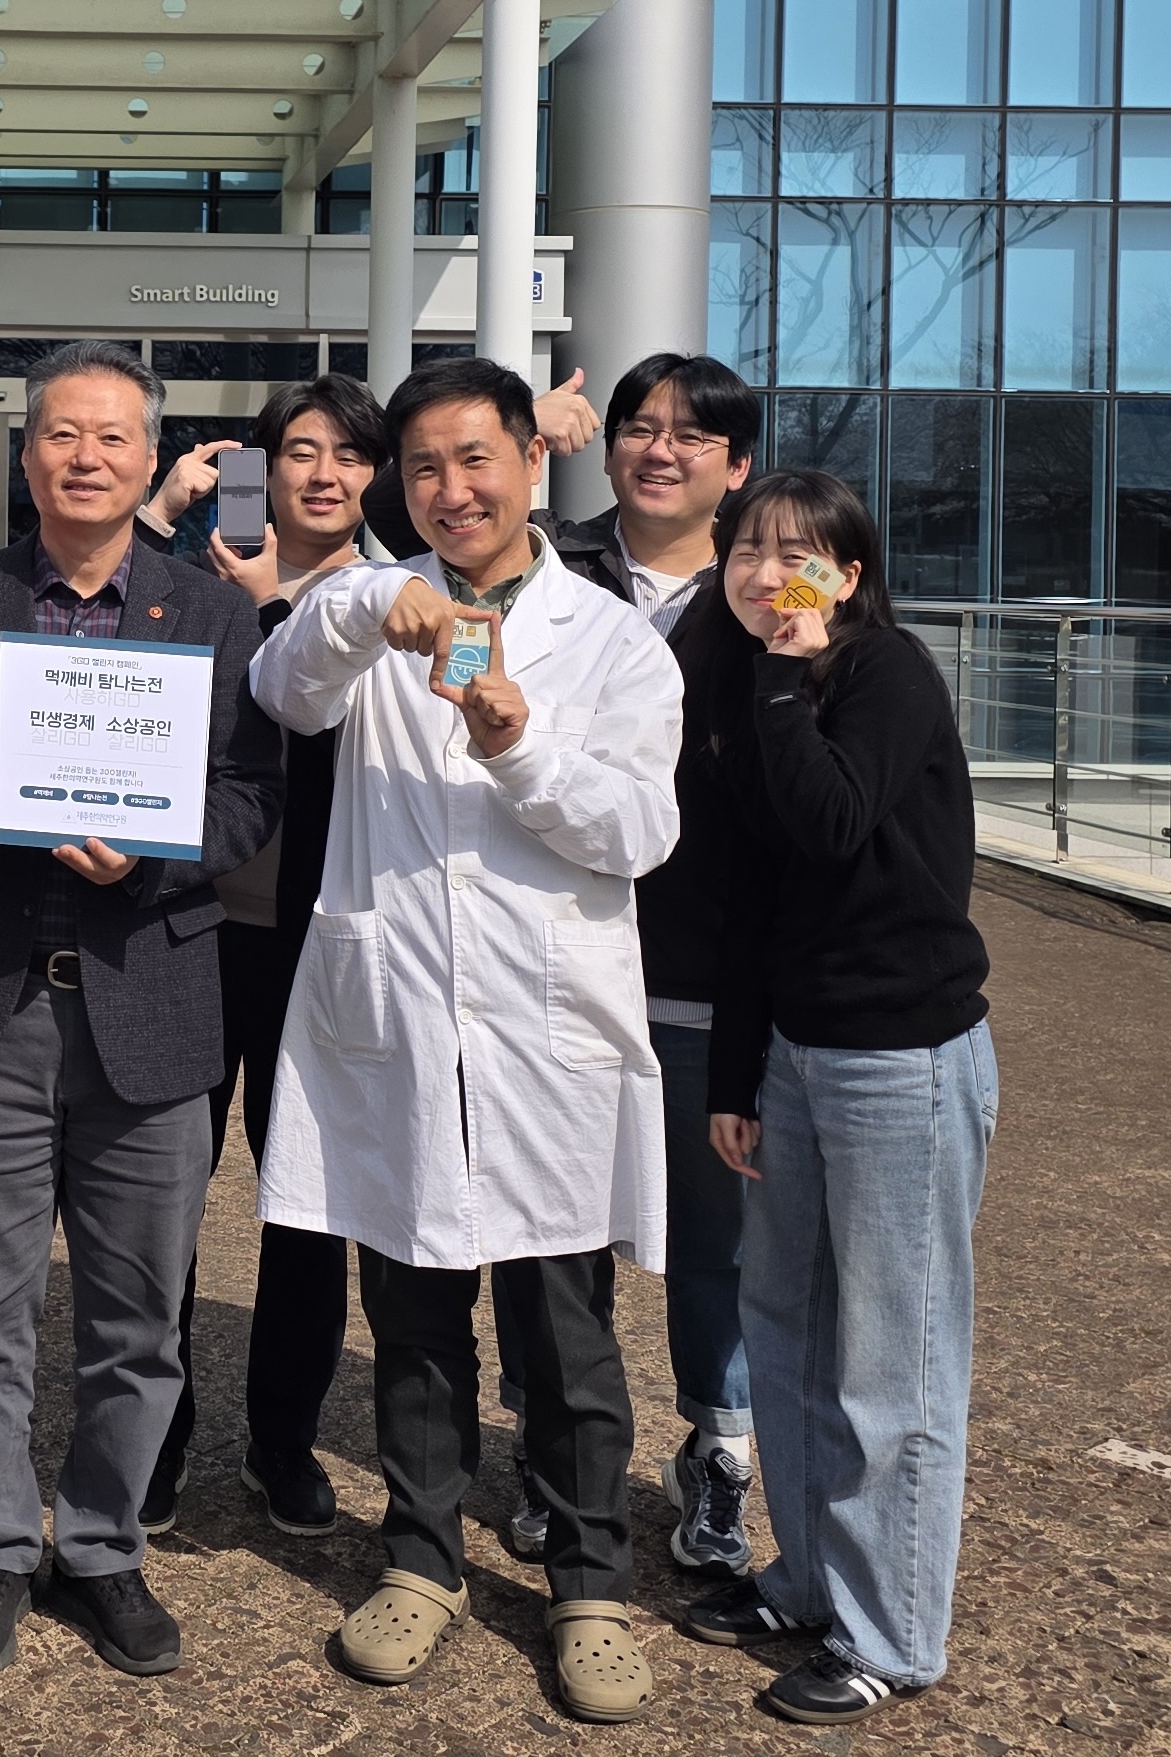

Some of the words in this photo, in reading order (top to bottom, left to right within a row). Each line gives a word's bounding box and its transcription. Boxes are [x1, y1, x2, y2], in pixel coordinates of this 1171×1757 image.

[130, 284, 190, 302] Smart
[195, 284, 279, 307] Building
[92, 658, 115, 668] 챌린지
[45, 669, 93, 688] 먹깨비
[98, 673, 163, 693] 탐나는전
[64, 688, 141, 708] 사용하GO
[30, 710, 95, 731] 민생경제
[106, 716, 172, 737] 소상공인
[107, 734, 168, 753] 살리GO
[57, 764, 83, 774] 소상공인
[124, 778, 144, 788] 합니다
